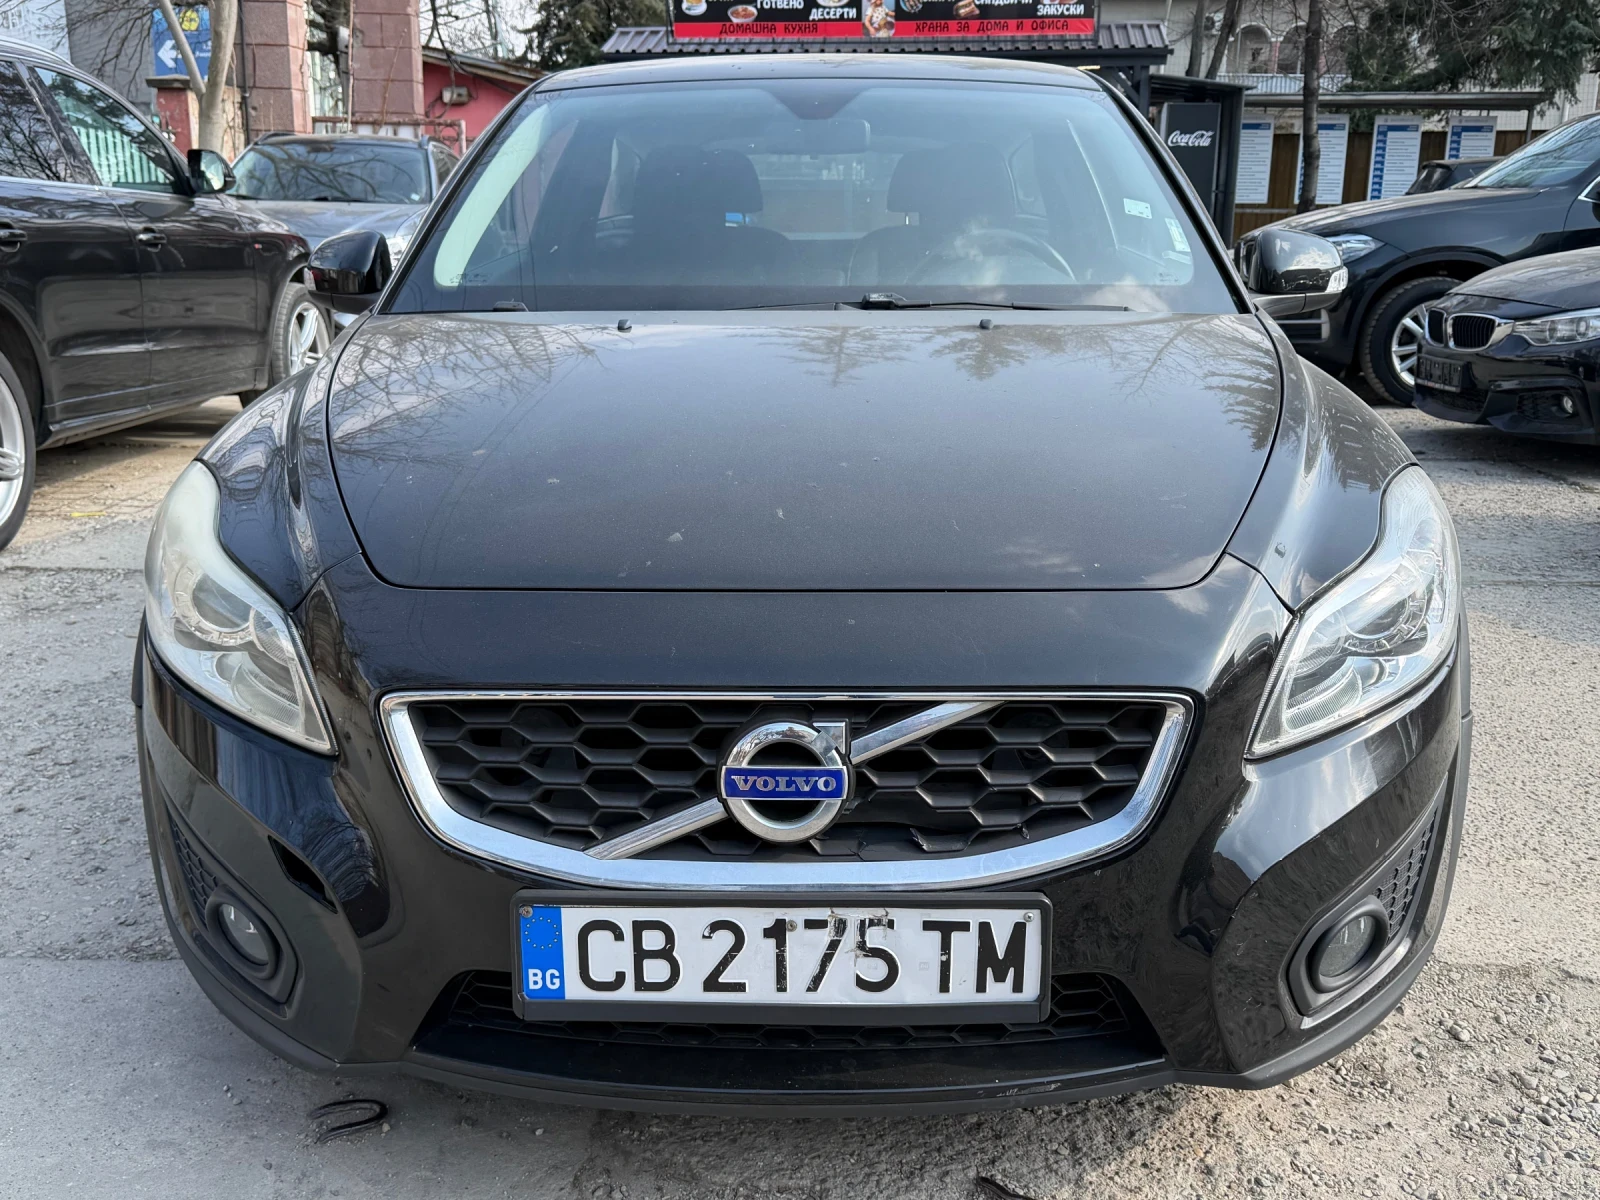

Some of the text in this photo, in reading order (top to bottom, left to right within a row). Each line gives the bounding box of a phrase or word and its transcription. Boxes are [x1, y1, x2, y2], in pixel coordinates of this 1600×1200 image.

[757, 0, 805, 9] ГОТВЕНО
[1036, 3, 1085, 15] ЗАКУСКИ
[809, 8, 857, 21] ДЕСЕРТИ
[719, 23, 819, 35] ДОМАШНА КУХНЯ
[915, 19, 1069, 33] ХРАНА ЗА ДОМА И ОФИСА
[731, 776, 836, 791] VOLVO
[701, 919, 901, 993] 2175
[921, 920, 1027, 994] TM
[527, 968, 561, 992] BG
